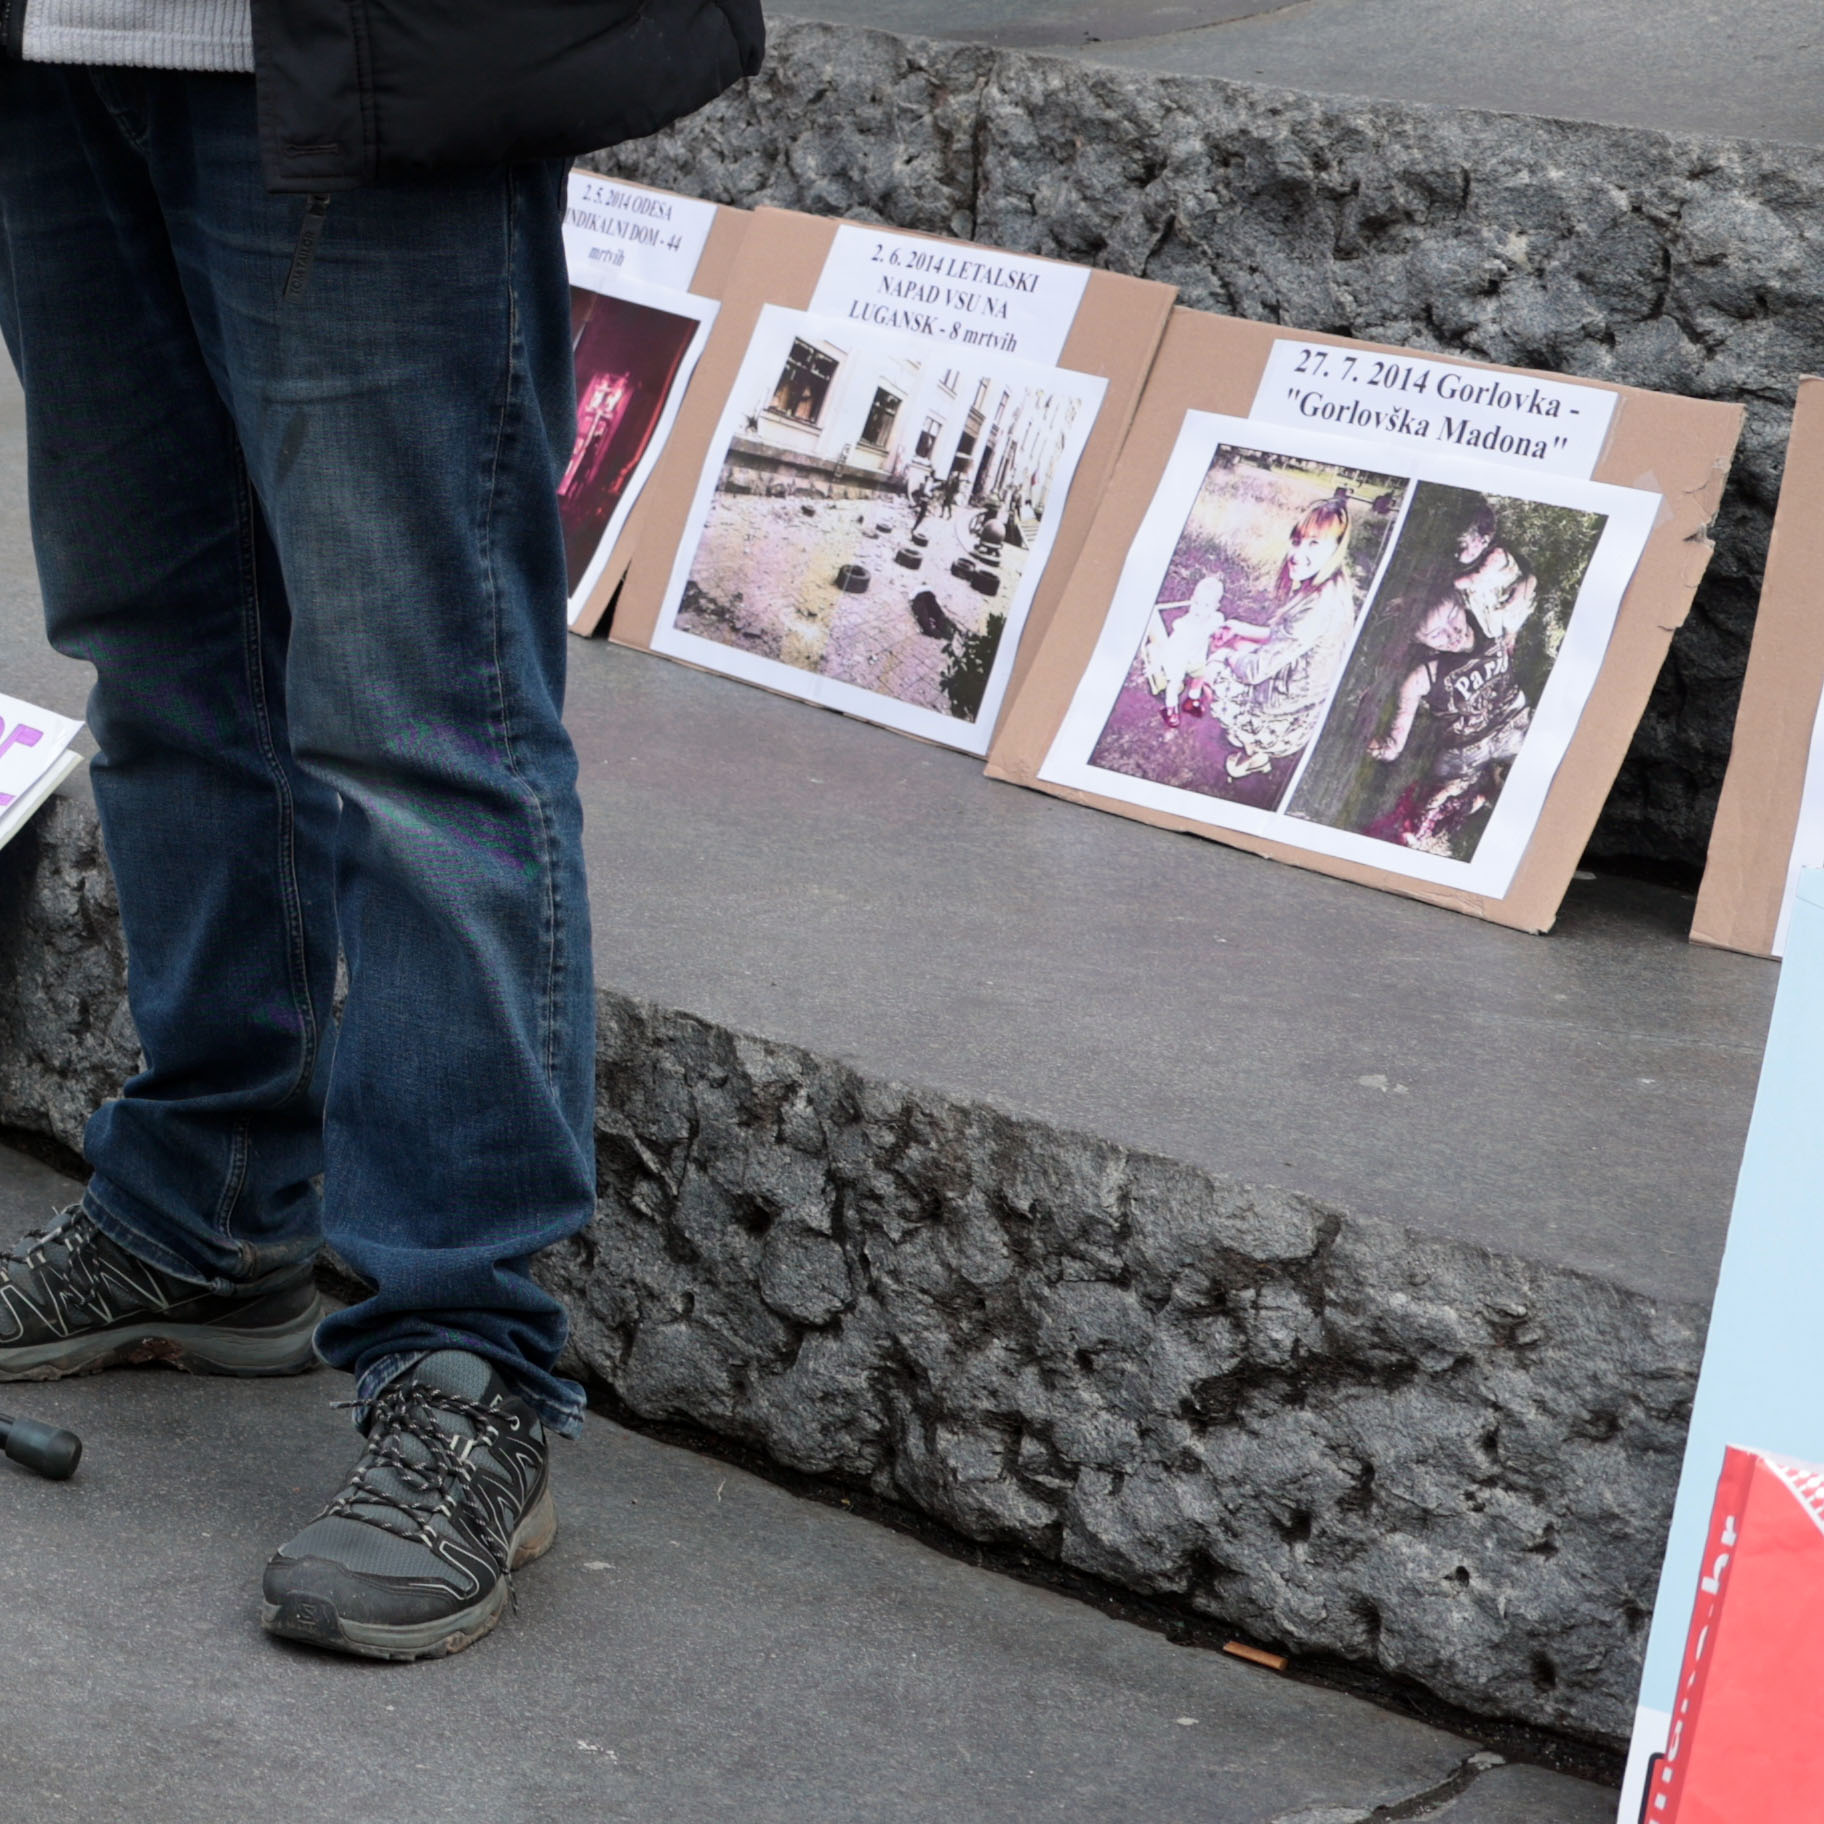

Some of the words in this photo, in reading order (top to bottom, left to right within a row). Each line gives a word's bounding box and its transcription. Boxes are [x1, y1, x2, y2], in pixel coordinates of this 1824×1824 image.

[566, 207, 628, 239] INDIKALNI
[628, 223, 660, 247] DOM
[632, 195, 673, 221] ODESA
[906, 251, 944, 274] 2014
[945, 258, 1040, 293] LETALSKI
[877, 275, 940, 304] NAPAD
[944, 289, 981, 313] VSU
[982, 297, 1009, 319] NA
[849, 299, 939, 335] LUGANSK
[949, 321, 962, 340] 8
[962, 329, 1017, 353] mrtvih
[1293, 349, 1329, 378] 27.
[1340, 356, 1358, 383] 7.
[1367, 361, 1431, 394] 2014
[1437, 372, 1562, 418] Gorlovka
[1287, 388, 1430, 438] "Gorlovška
[1439, 415, 1568, 460] Madona"
